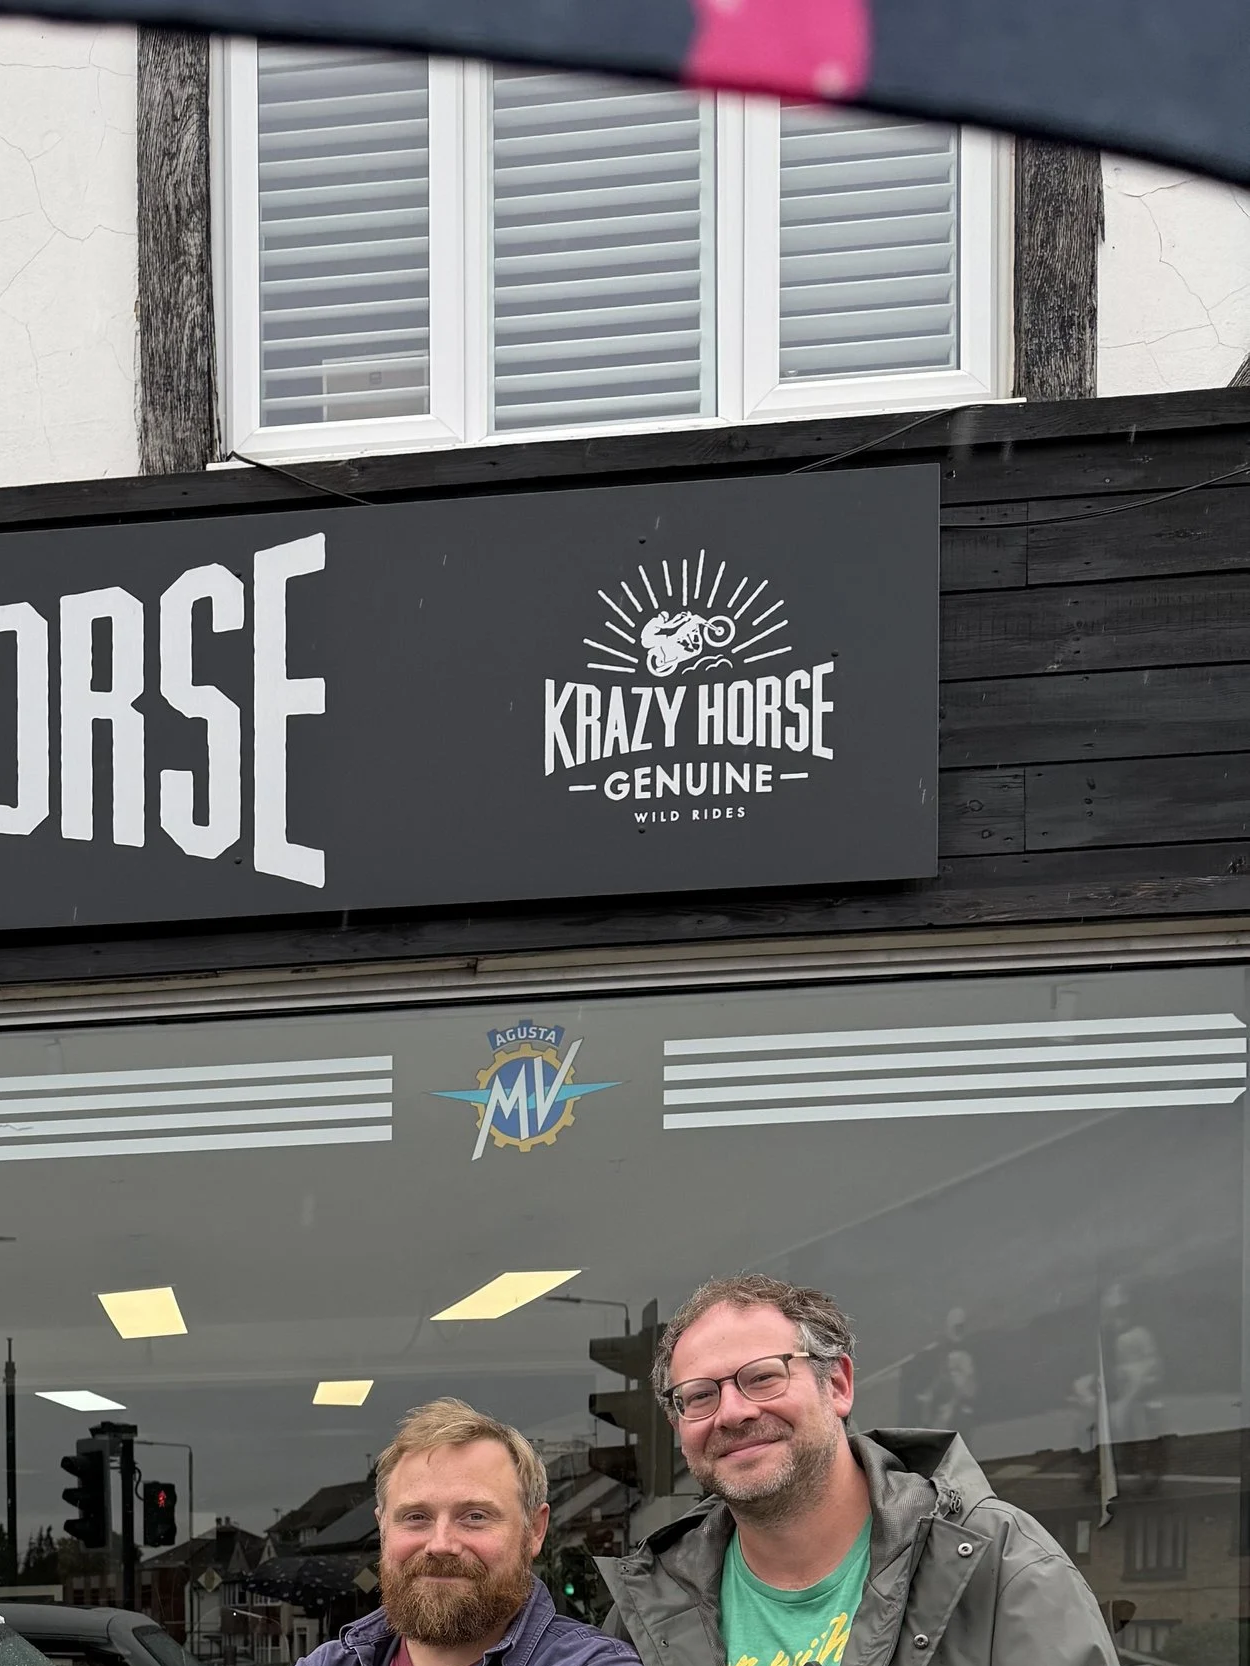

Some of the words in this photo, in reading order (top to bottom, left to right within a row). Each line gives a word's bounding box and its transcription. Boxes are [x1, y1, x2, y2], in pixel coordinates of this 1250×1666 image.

[545, 678, 687, 776] KRAZY
[698, 661, 835, 760] HORSE
[603, 762, 773, 801] GENUINE
[634, 810, 680, 823] WILD
[692, 806, 745, 821] RIDES
[495, 1026, 556, 1047] AGUSTA
[471, 1037, 584, 1161] MV
